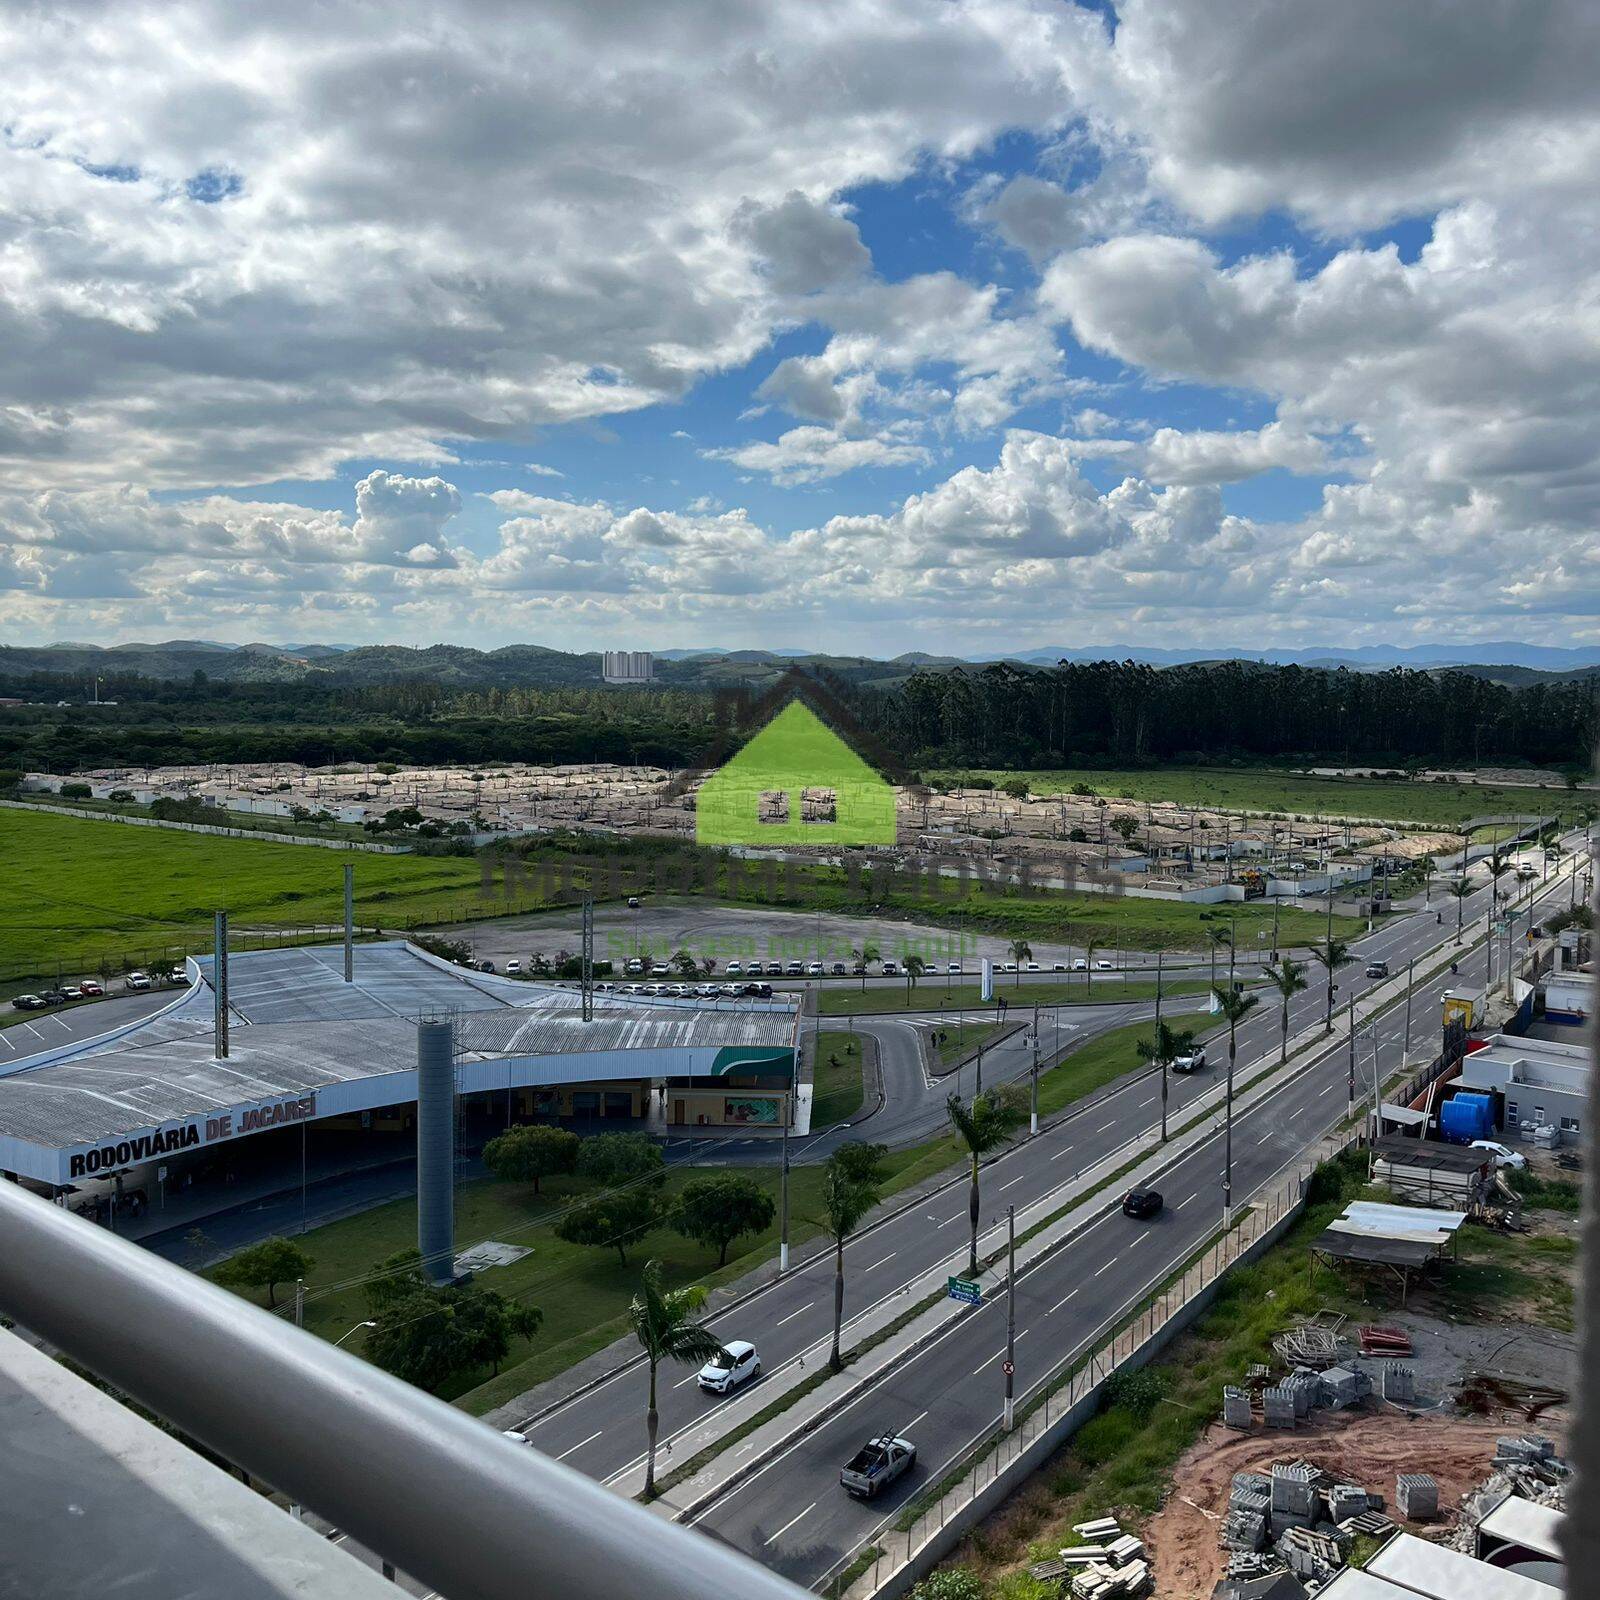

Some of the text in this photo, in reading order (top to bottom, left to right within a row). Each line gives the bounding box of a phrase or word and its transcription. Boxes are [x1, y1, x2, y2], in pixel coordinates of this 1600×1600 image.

[70, 1091, 316, 1178] RODOVIÁRIA DE JACAREÍ
